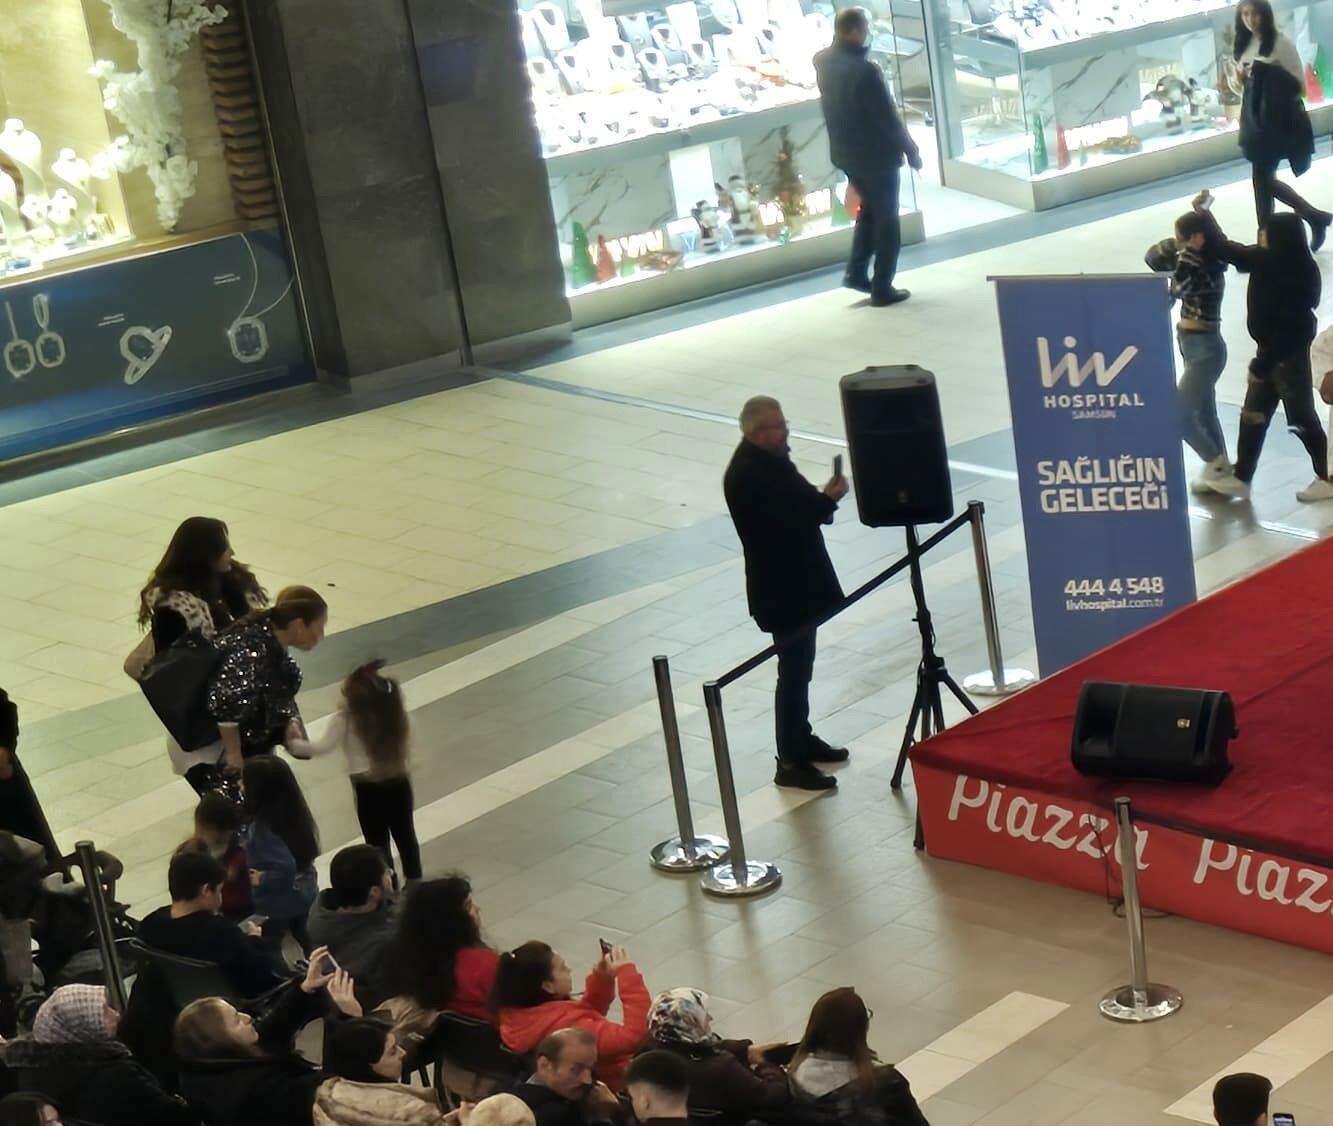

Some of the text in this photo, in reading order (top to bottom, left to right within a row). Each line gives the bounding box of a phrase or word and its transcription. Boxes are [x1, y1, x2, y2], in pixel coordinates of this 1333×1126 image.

[1043, 393, 1144, 408] HOSPITAL
[1037, 454, 1166, 485] SAĞLIĞIN
[1040, 482, 1169, 513] GELECEĞİ
[1064, 576, 1164, 596] 444 4 548
[1066, 598, 1163, 611] livhospital.com.tr
[948, 774, 1150, 872] Piazza
